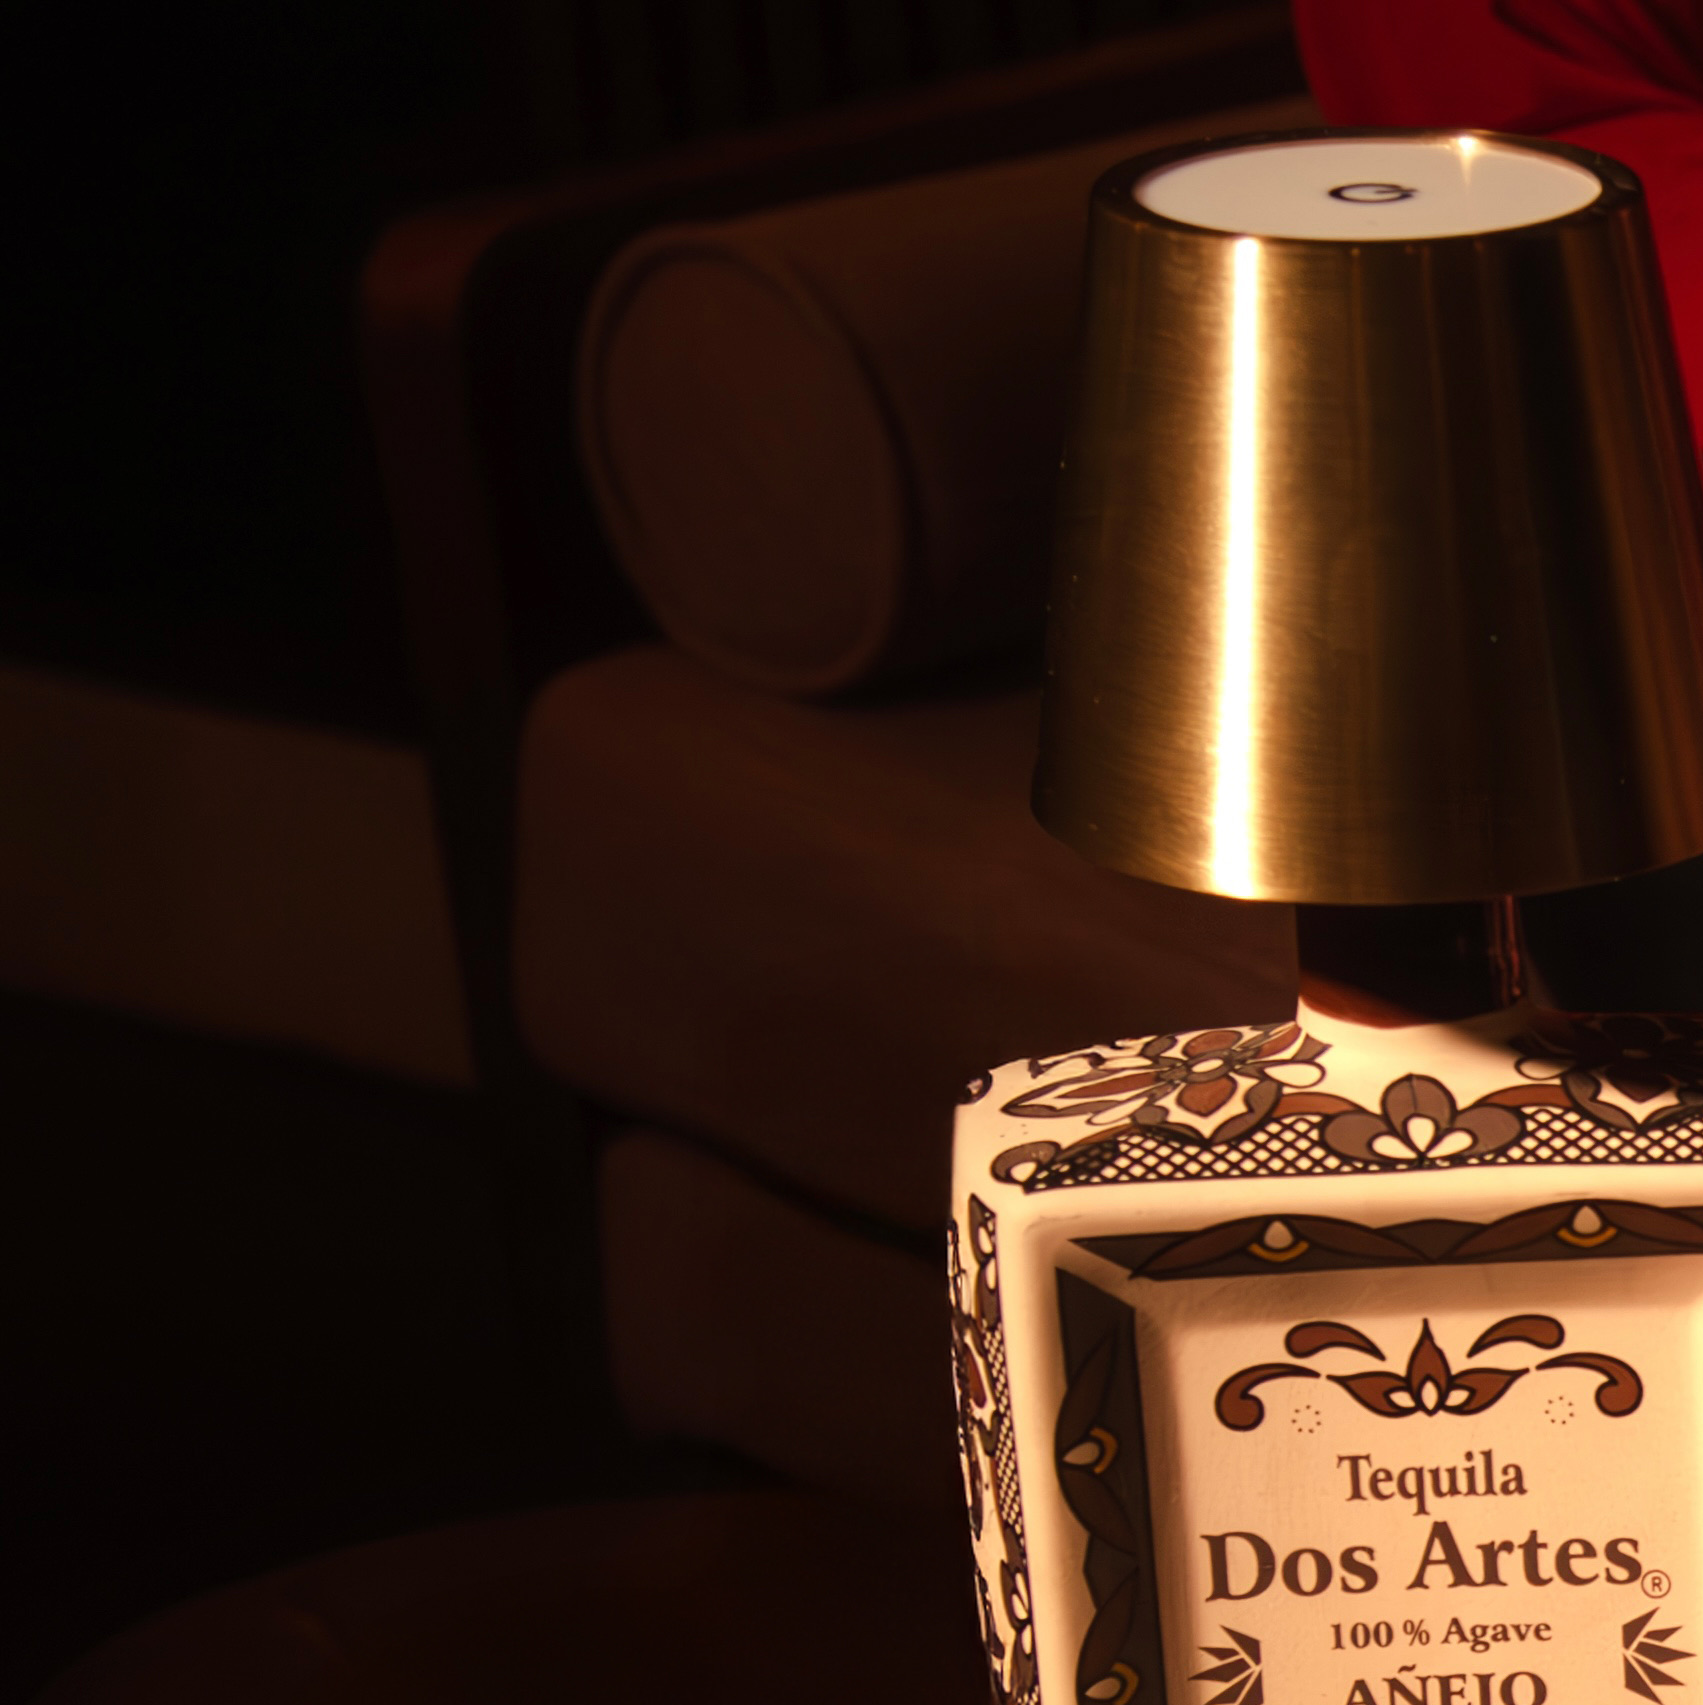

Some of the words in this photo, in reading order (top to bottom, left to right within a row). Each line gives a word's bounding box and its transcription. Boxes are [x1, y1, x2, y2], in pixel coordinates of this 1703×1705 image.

[1337, 1449, 1527, 1516] Tequila
[1200, 1532, 1378, 1602] Dos
[1441, 1617, 1551, 1653] Agave
